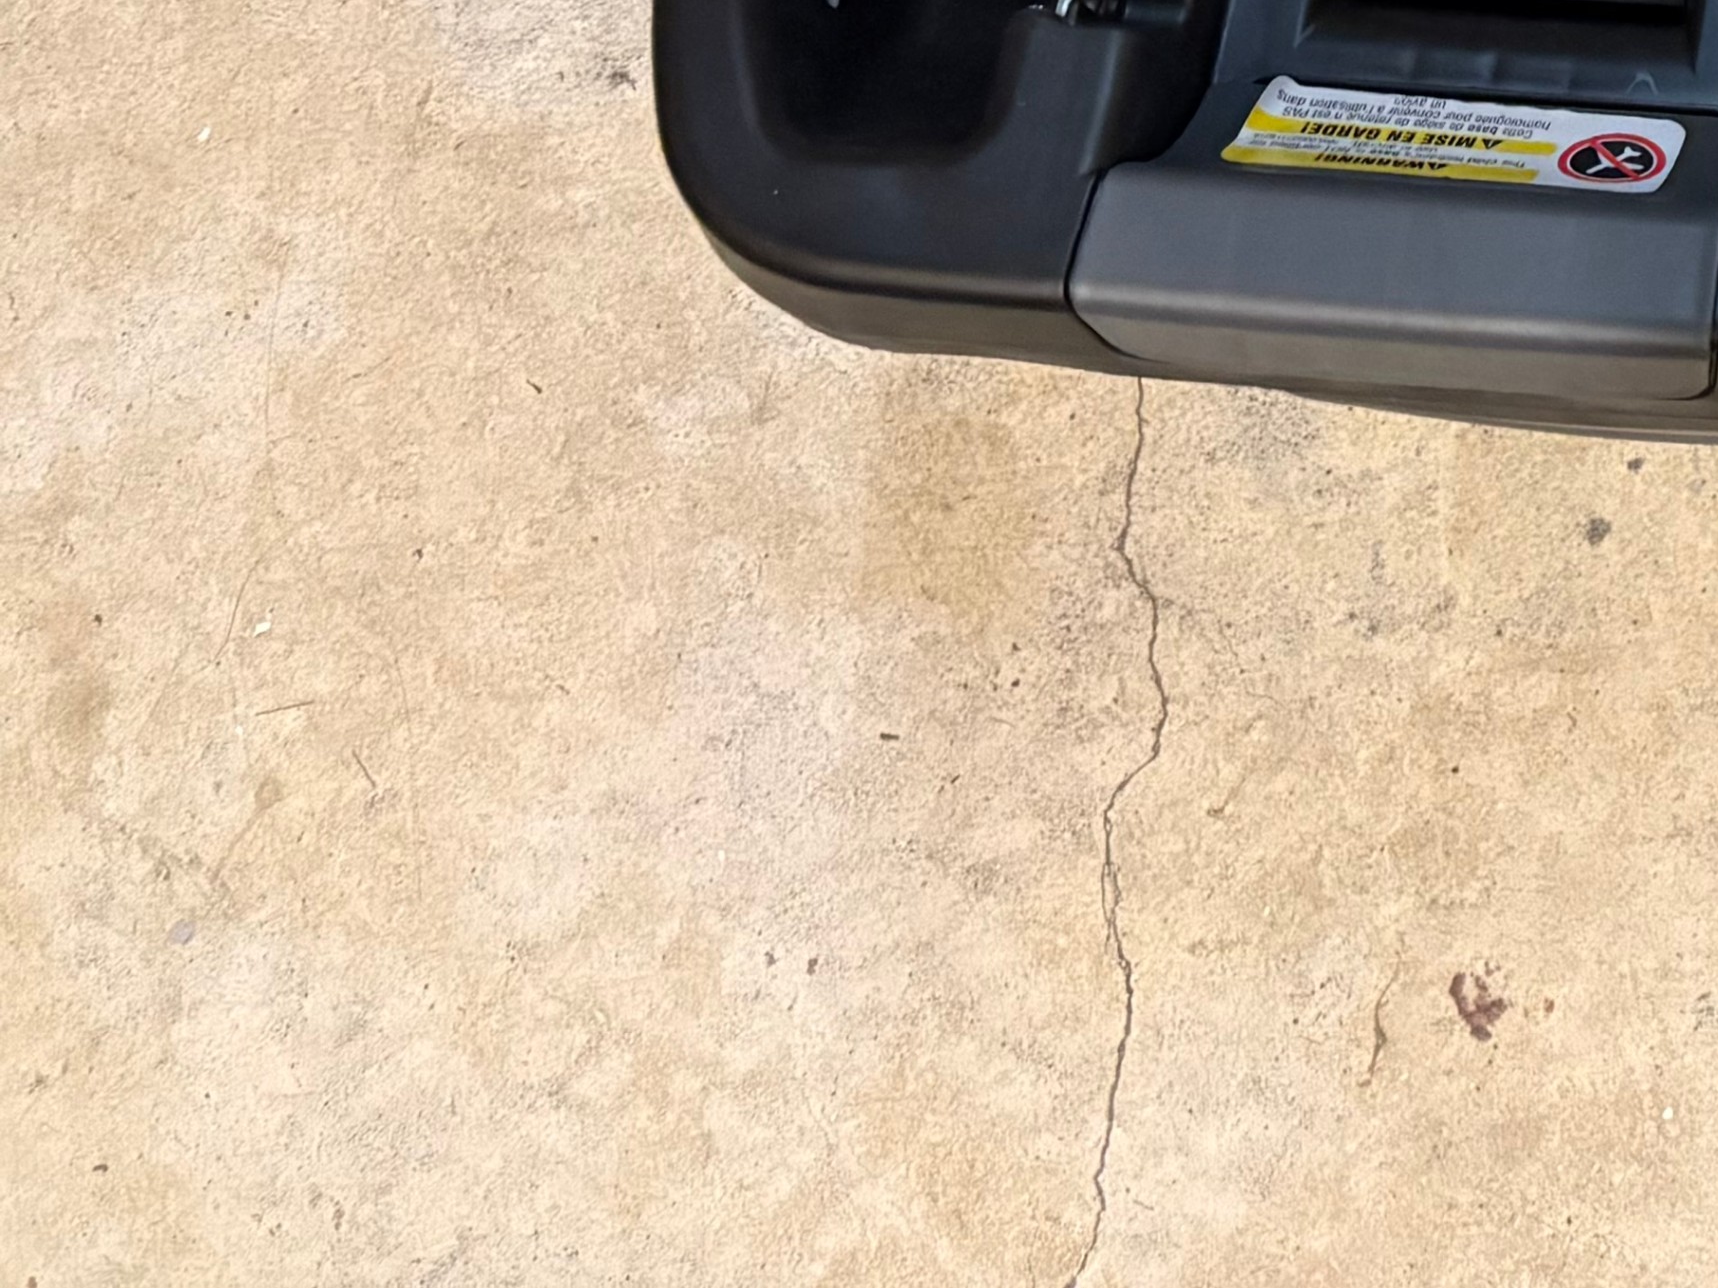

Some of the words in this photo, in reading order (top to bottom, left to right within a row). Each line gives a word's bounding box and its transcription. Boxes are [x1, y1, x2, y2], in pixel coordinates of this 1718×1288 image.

[1300, 120, 1381, 140] GARDE!
[1385, 128, 1416, 143] EN
[1419, 132, 1477, 148] MISE
[1313, 151, 1426, 170] WARNING!
